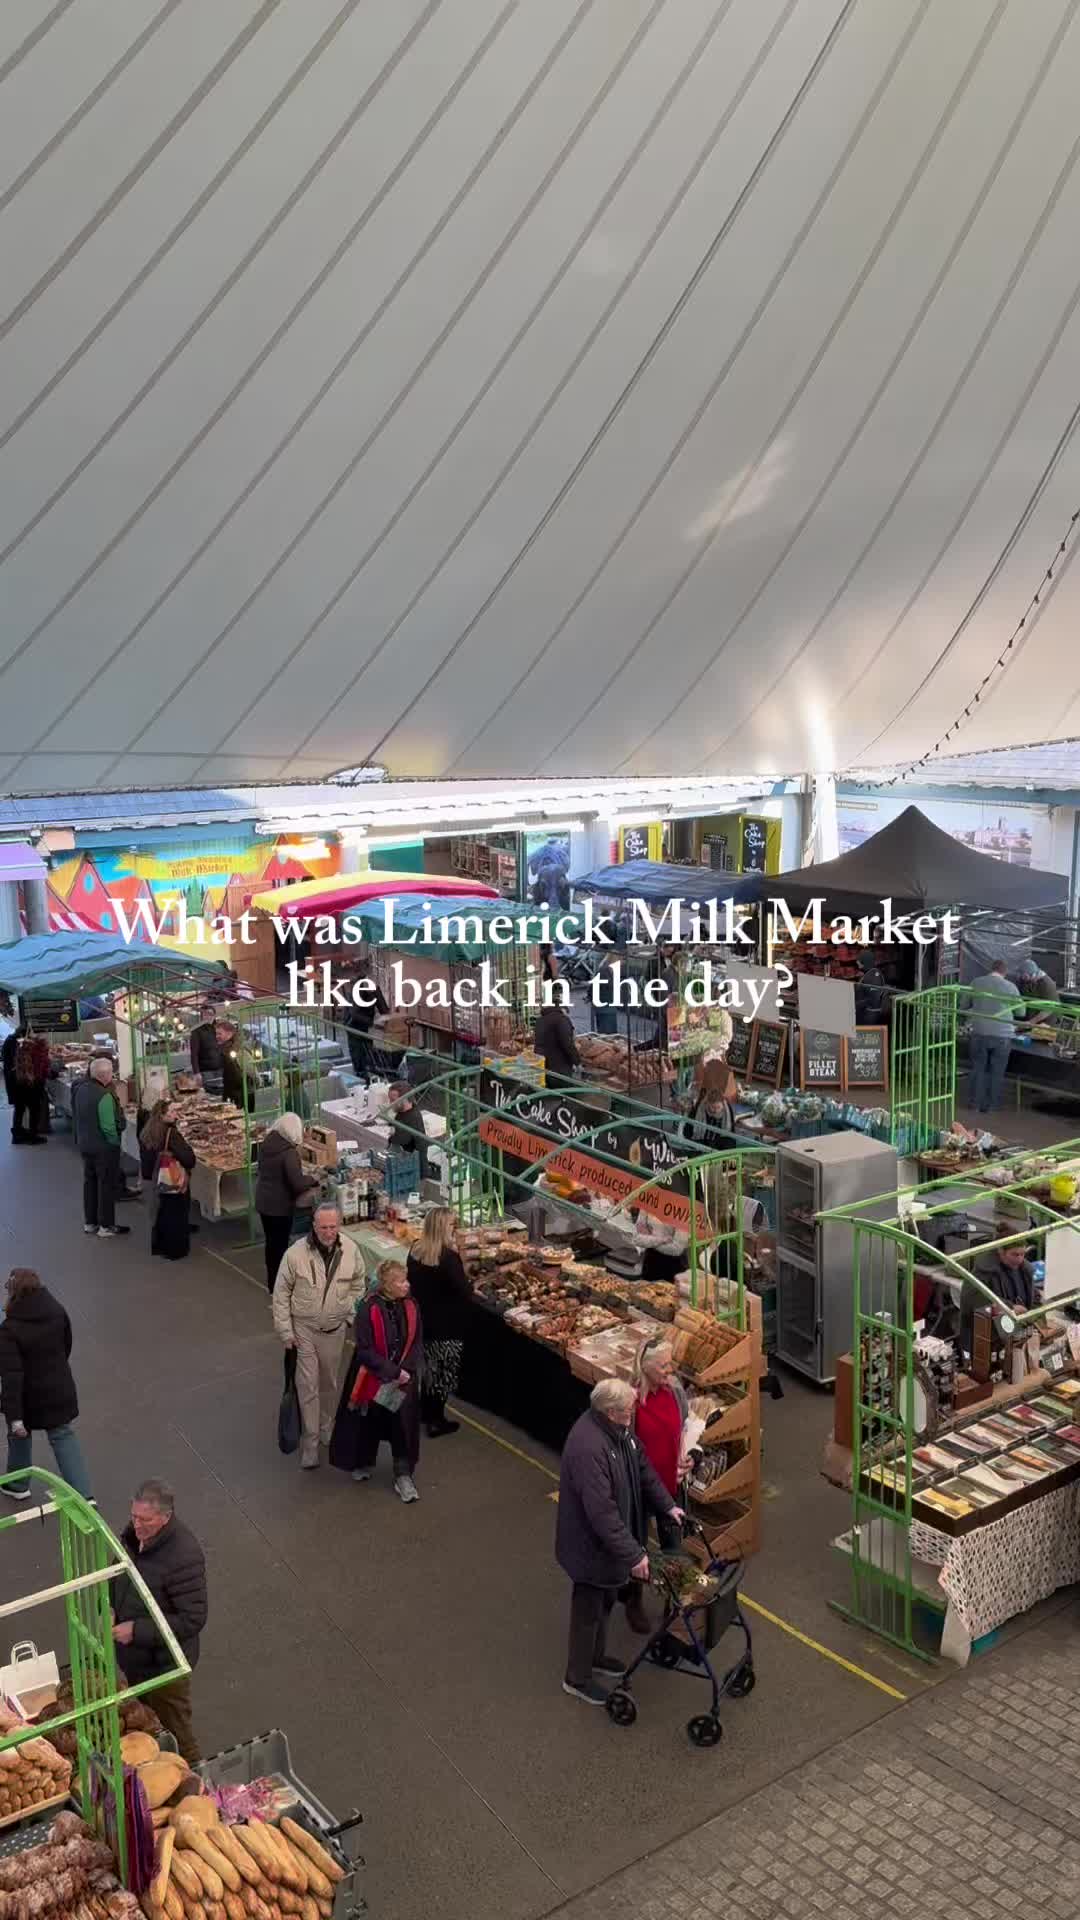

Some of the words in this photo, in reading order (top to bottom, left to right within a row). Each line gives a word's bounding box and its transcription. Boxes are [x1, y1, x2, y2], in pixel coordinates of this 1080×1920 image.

[490, 1080, 513, 1110] The
[516, 1093, 553, 1125] Cake
[487, 1119, 522, 1153] Proudly
[579, 1164, 633, 1196] produced
